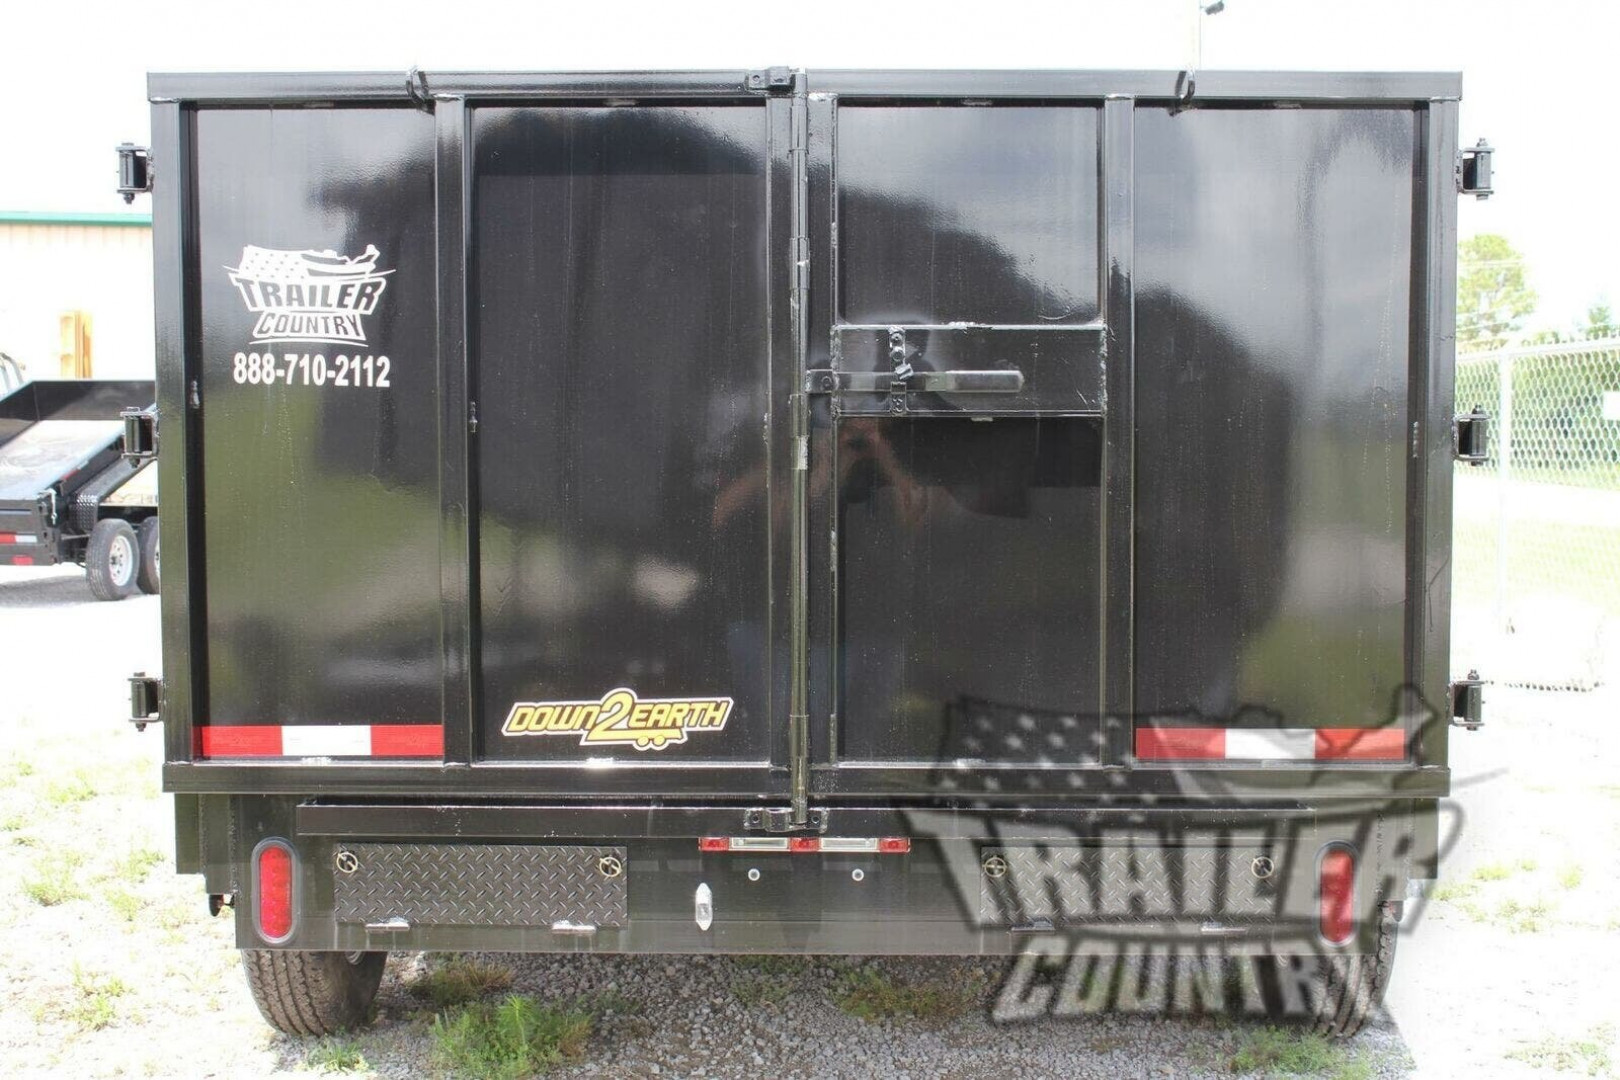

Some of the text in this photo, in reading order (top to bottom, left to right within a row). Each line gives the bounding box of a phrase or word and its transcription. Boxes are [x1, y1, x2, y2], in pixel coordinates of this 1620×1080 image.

[233, 276, 384, 314] TRAILER
[255, 314, 364, 338] COUNTRY
[233, 352, 391, 387] 888-710-2112
